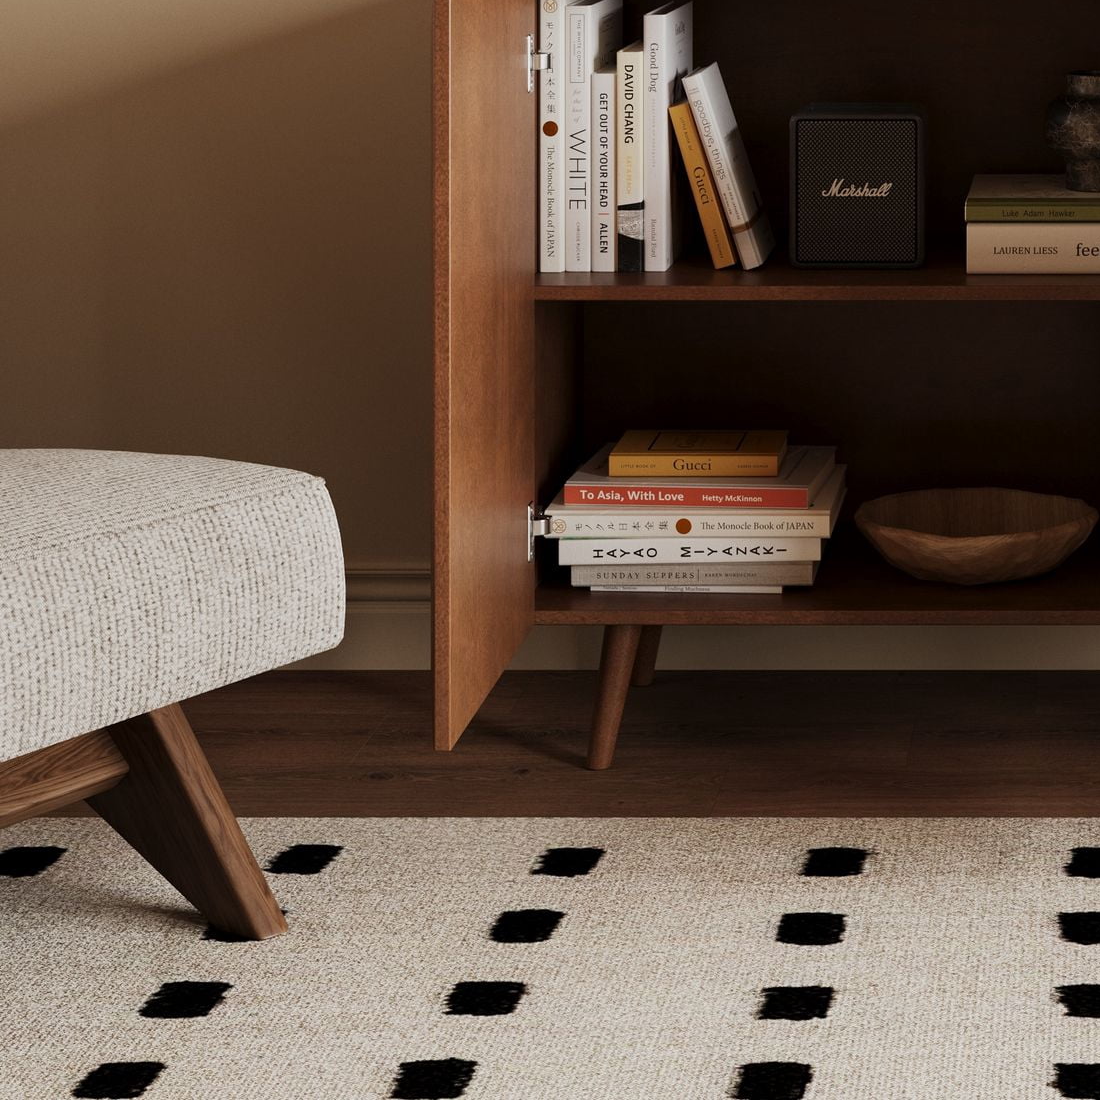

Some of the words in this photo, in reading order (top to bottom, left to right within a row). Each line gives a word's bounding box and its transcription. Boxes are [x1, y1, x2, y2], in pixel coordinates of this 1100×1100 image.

[650, 43, 659, 69] Good
[625, 65, 634, 100] DAVID
[649, 73, 659, 92] Dog
[600, 93, 608, 111] GET
[600, 114, 608, 134] OUT
[624, 104, 634, 144] CHANG
[600, 137, 608, 149] OF
[693, 100, 714, 148] goodbye,
[711, 147, 727, 180] things
[547, 148, 555, 160] The
[569, 129, 587, 210] WHITE
[600, 152, 608, 178] YOUR
[547, 162, 555, 196] Monocle
[693, 166, 713, 205] Gucci
[822, 178, 893, 197] Marshall
[600, 181, 608, 208] HEAD
[547, 198, 555, 218] Book
[547, 220, 555, 228] of
[547, 230, 555, 257] JAPAN
[600, 223, 608, 253] ALLEN
[994, 247, 1031, 255] LAUREN
[1033, 247, 1058, 255] LIESS
[673, 459, 711, 471] Gucci
[580, 490, 595, 500] To
[597, 490, 624, 502] Asia,
[627, 491, 655, 501] With
[659, 491, 684, 501] Love
[702, 495, 724, 503] Hetty
[700, 521, 715, 530] The
[717, 521, 752, 530] Monocle
[754, 521, 774, 530] Book
[775, 521, 785, 530] of
[785, 521, 814, 530] JAPAN
[593, 548, 658, 558] HAYAO
[681, 546, 787, 558] MIYAZAKI
[597, 572, 640, 580] SUNDAY
